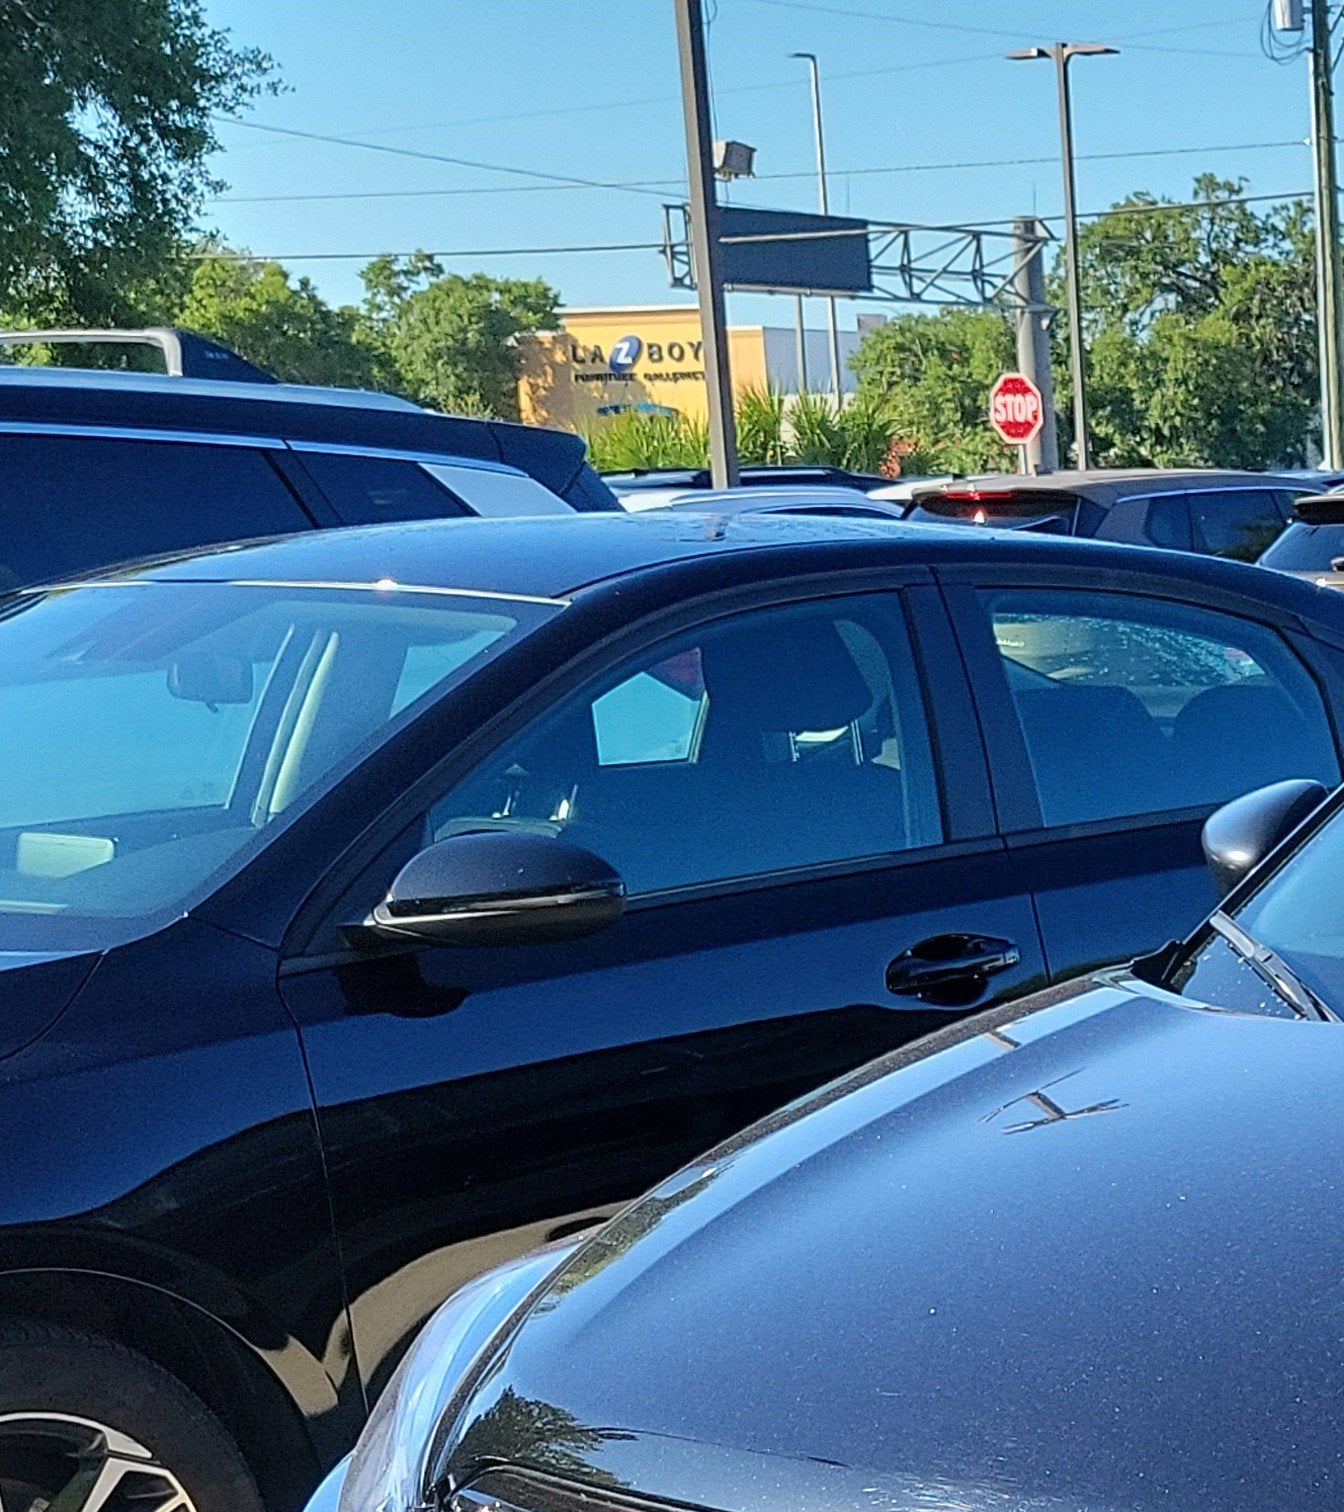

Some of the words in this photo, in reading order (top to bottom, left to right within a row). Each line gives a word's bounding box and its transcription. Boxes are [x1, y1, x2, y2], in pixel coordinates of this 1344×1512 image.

[570, 344, 607, 364] LA
[646, 340, 703, 363] BOY
[994, 393, 1038, 423] STOP
